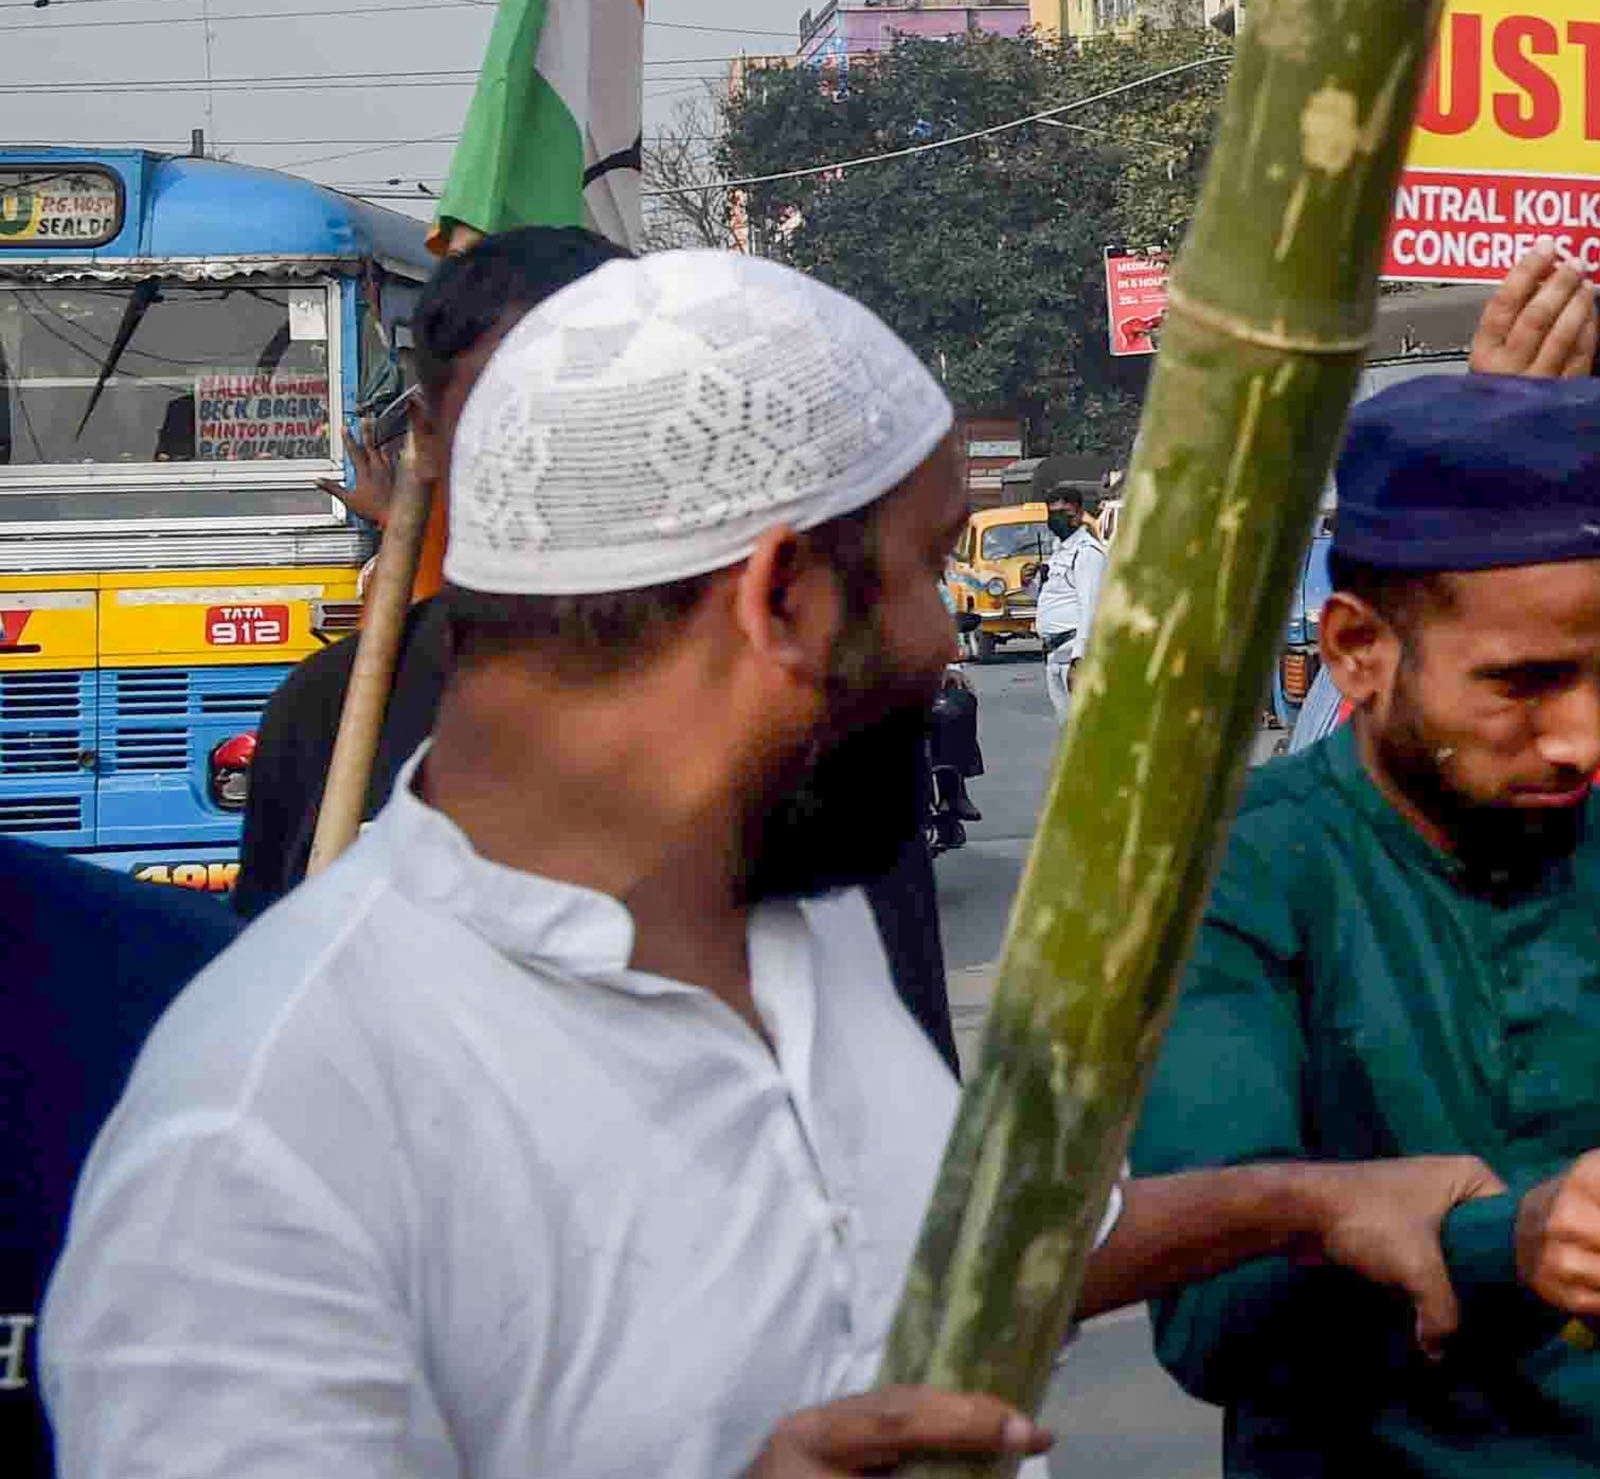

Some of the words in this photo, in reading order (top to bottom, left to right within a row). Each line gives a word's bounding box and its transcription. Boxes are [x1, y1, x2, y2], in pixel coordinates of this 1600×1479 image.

[1395, 184, 1507, 223] NTRAL
[220, 607, 264, 620] TATA
[211, 621, 280, 644] 912
